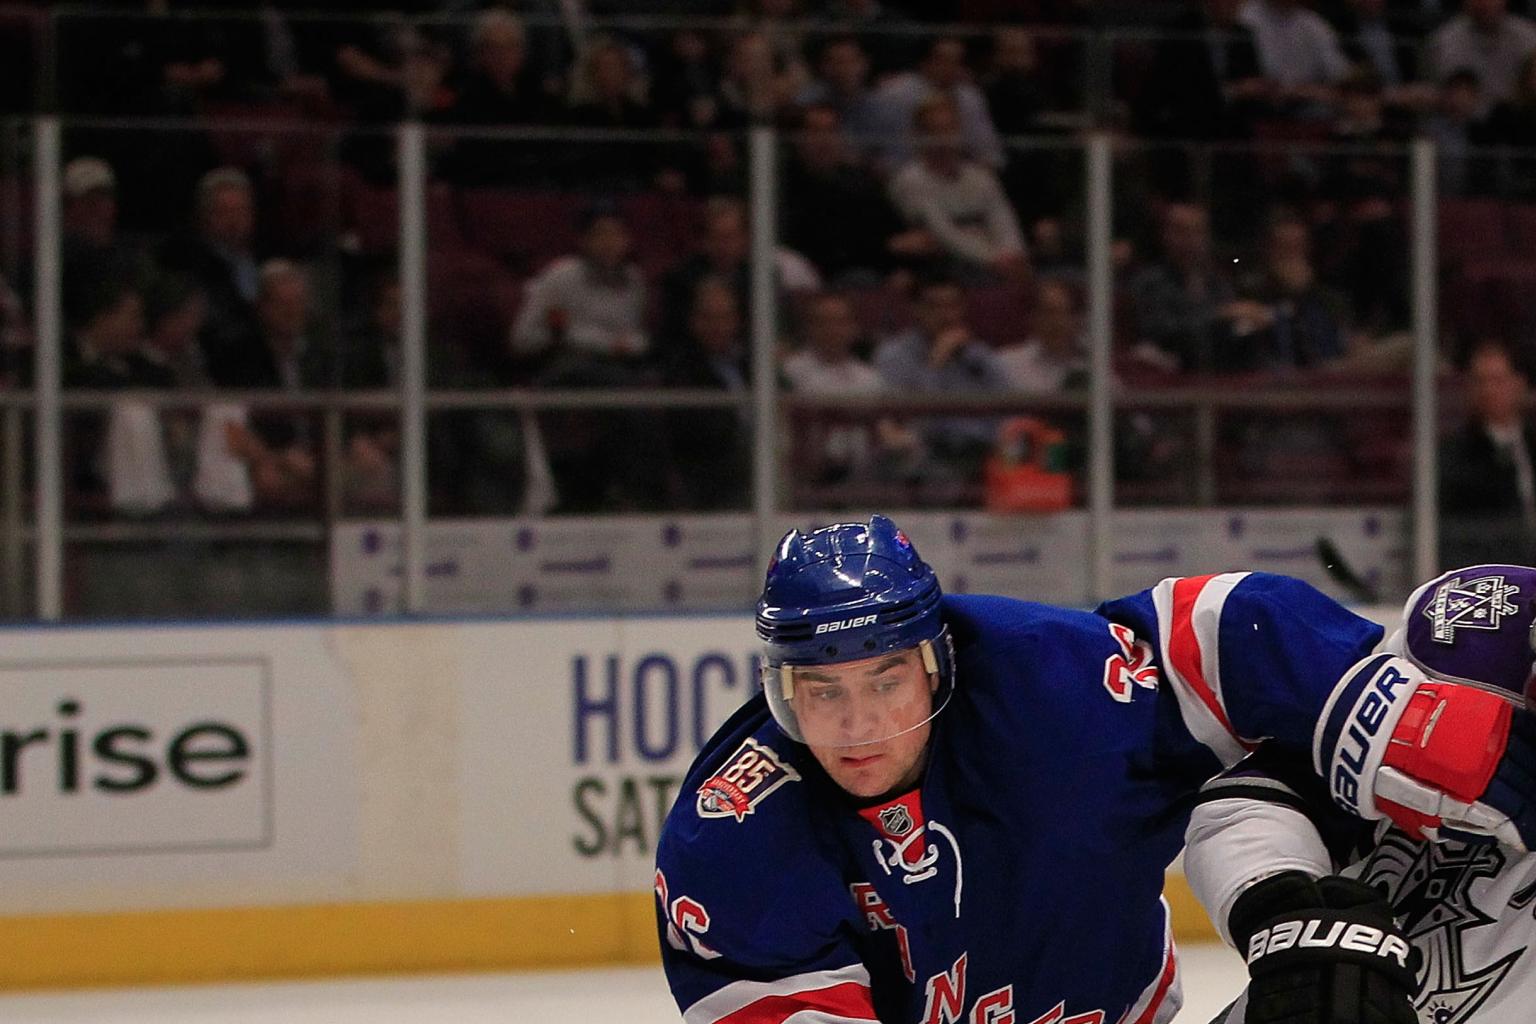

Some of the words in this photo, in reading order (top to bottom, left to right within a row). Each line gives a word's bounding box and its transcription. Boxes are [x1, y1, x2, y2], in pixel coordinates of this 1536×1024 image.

[815, 614, 878, 635] BAUER
[571, 651, 763, 765] HOC
[0, 699, 251, 795] rise
[721, 750, 776, 794] 85
[1247, 918, 1412, 969] BAUER
